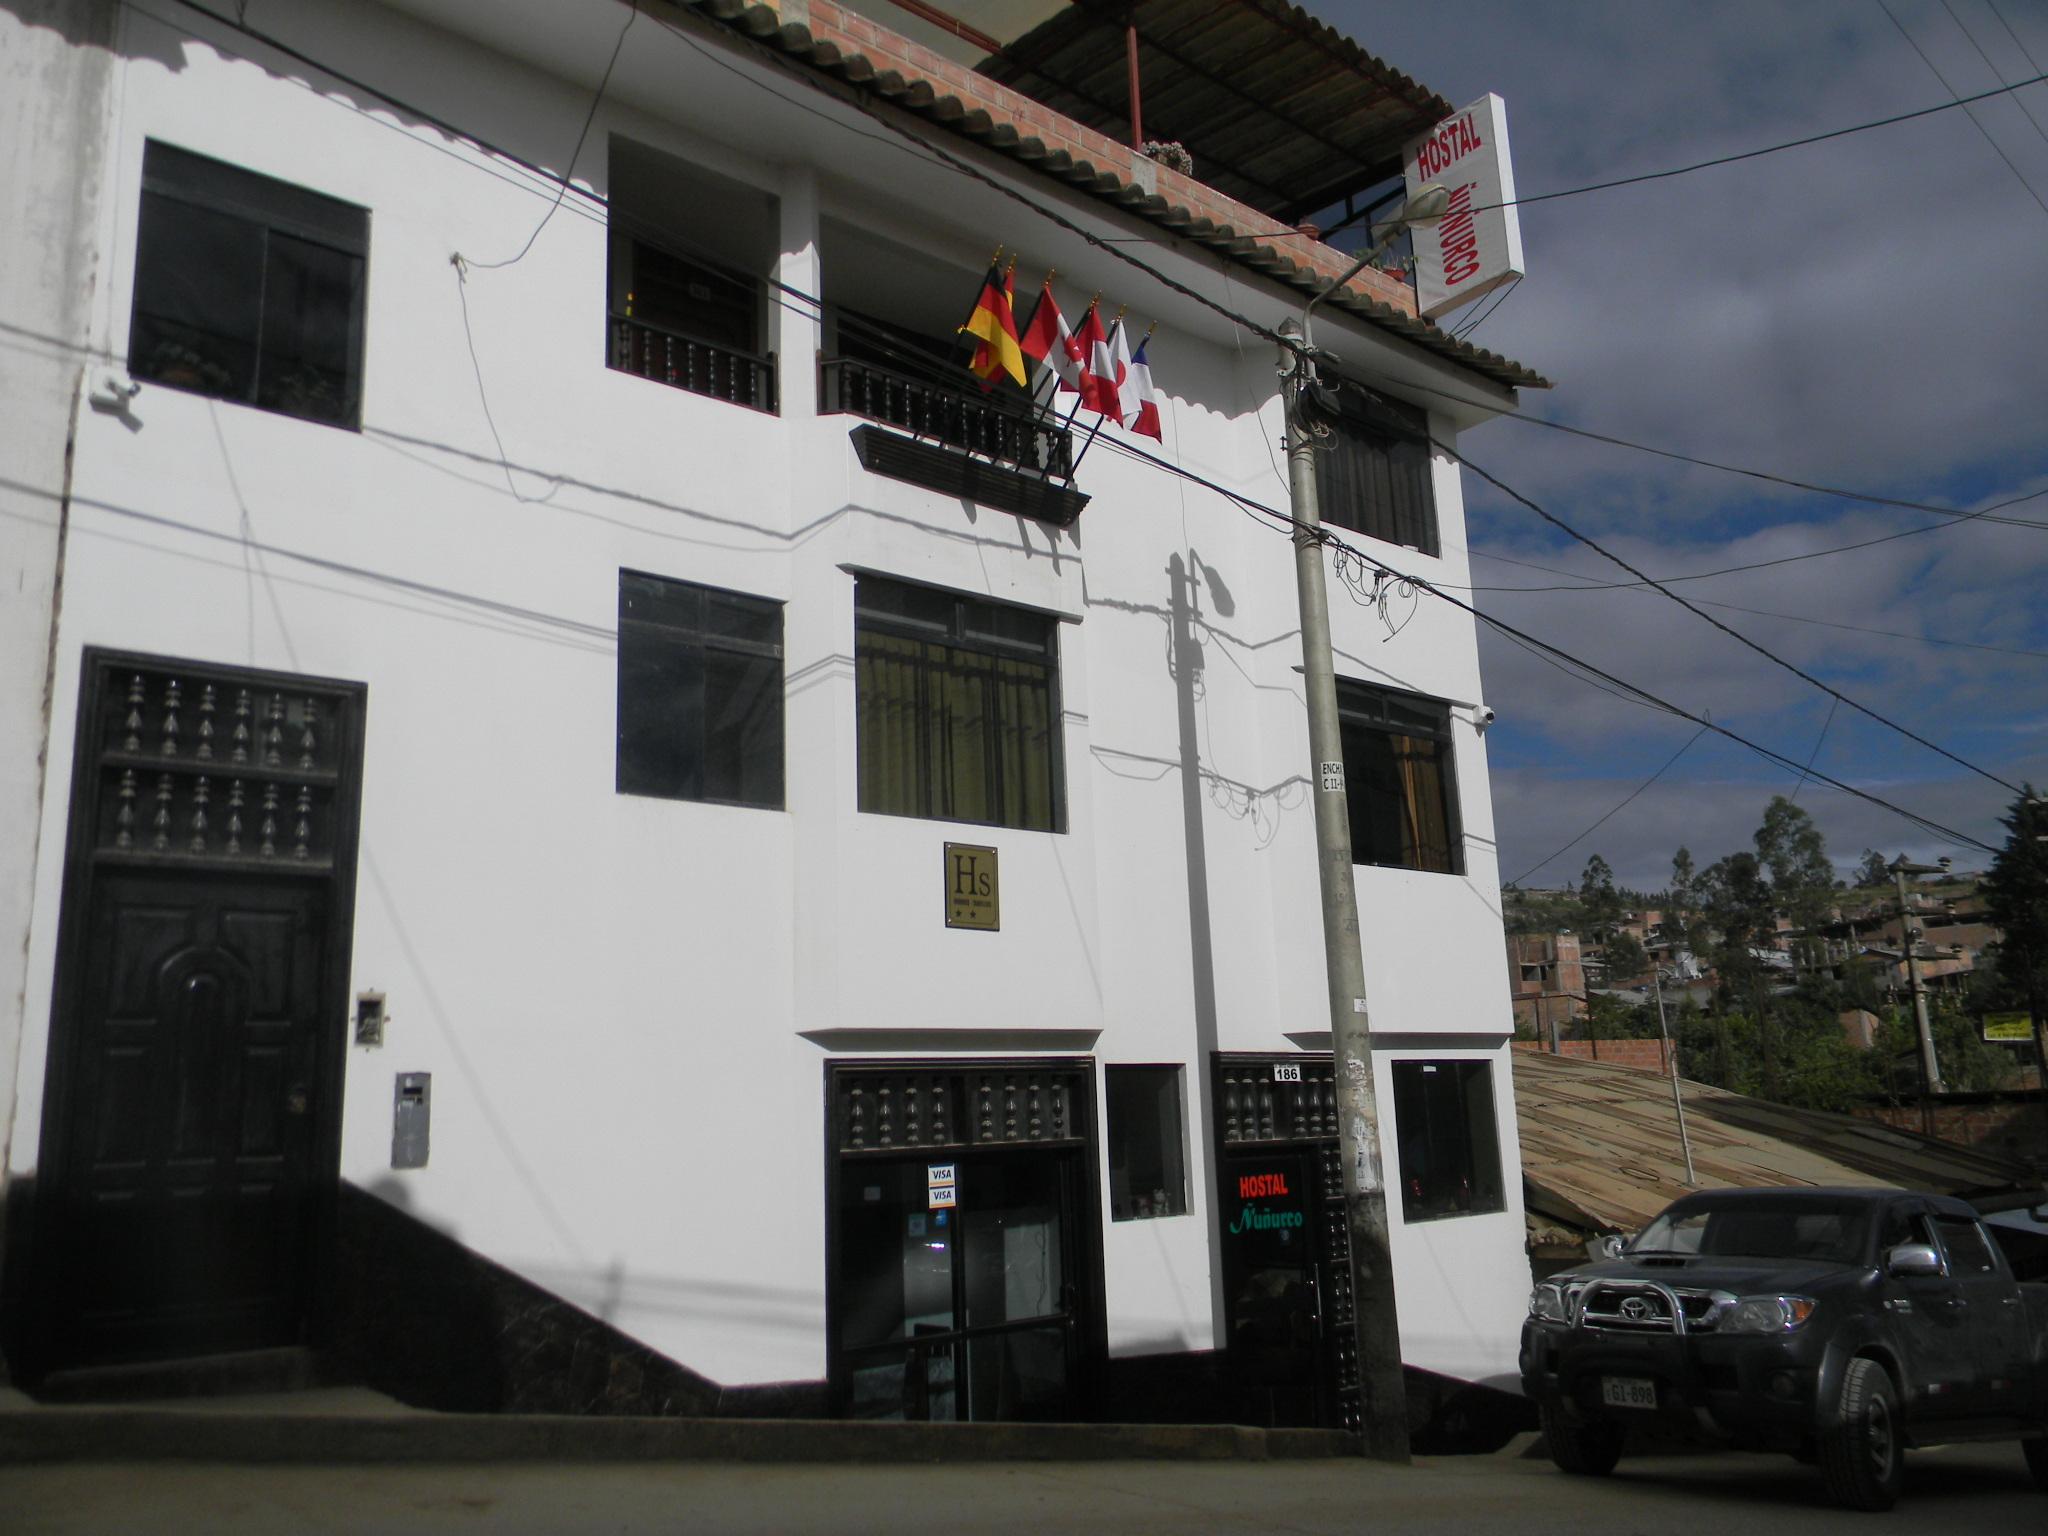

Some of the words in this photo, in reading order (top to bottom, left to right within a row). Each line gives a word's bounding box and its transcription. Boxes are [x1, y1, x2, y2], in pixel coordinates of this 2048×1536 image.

[1416, 112, 1482, 182] HOSTAL
[1276, 1068, 1298, 1080] 186
[933, 1169, 952, 1180] VISA
[1239, 1173, 1289, 1199] HOSTAL
[934, 1190, 952, 1201] VISA
